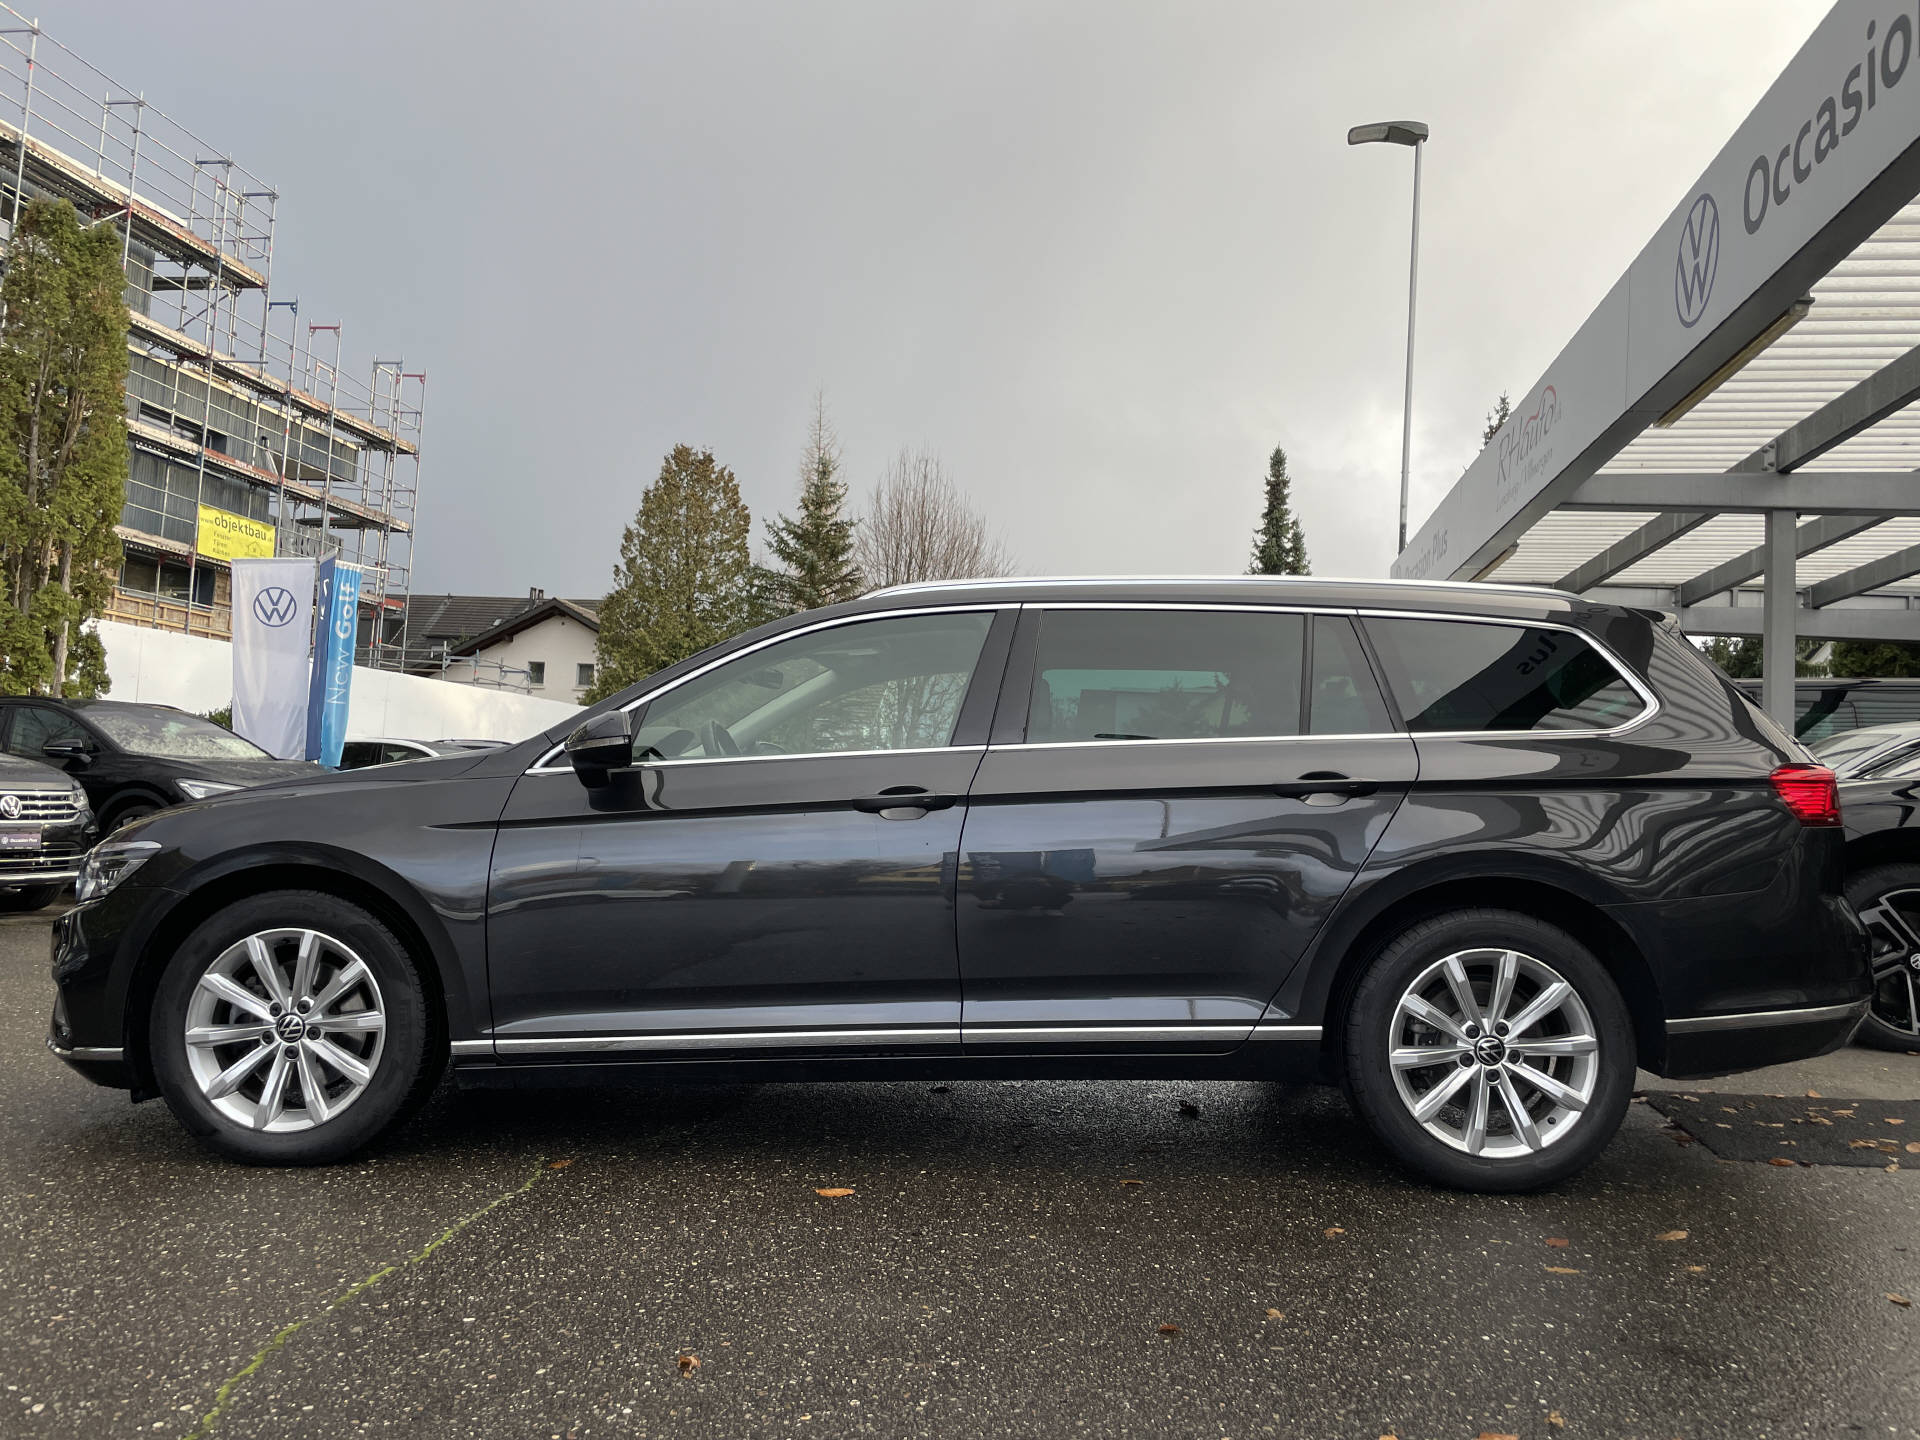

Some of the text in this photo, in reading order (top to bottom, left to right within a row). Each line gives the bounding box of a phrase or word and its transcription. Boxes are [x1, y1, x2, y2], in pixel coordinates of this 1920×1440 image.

[1743, 1, 1920, 235] Occasio
[327, 582, 355, 705] New Golf
